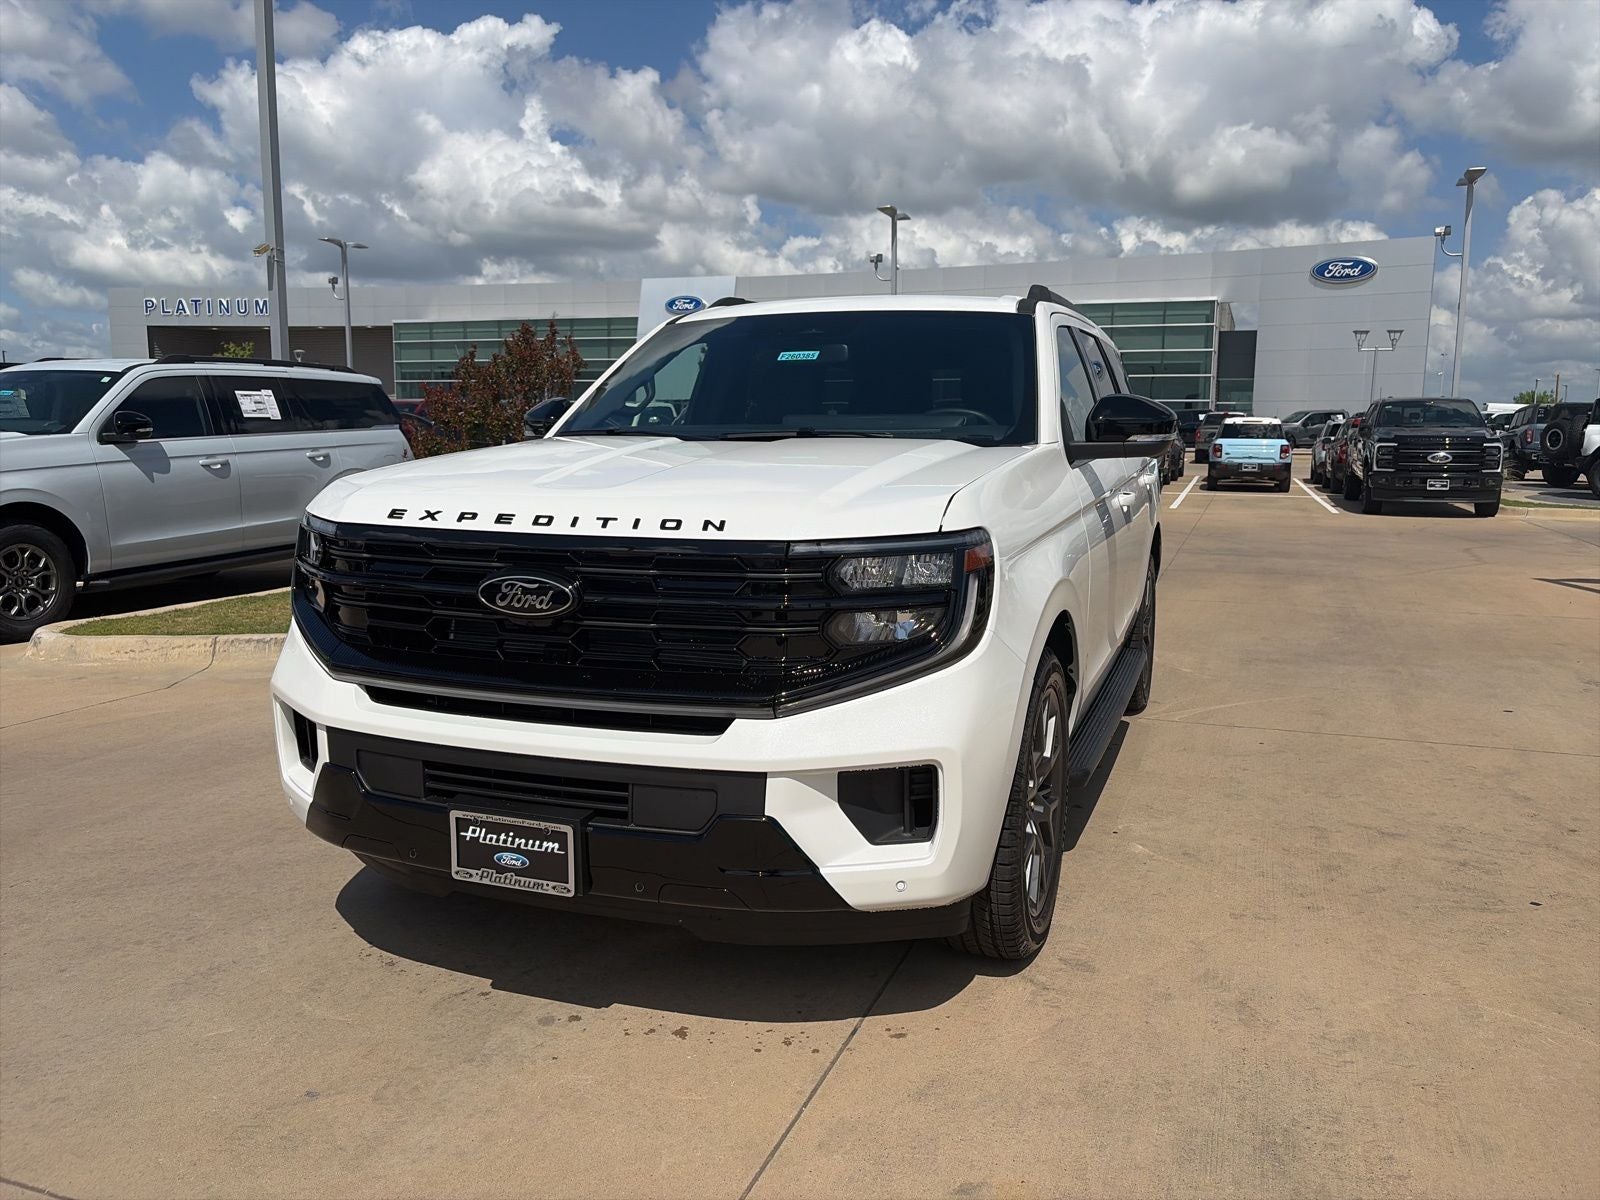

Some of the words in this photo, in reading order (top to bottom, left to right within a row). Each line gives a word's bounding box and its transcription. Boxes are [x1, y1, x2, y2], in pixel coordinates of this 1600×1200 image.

[1324, 261, 1363, 277] Ford
[144, 298, 270, 316] PLATINUM
[672, 299, 696, 310] Ford
[387, 508, 726, 532] EXPEDITION
[495, 580, 553, 610] Ford
[460, 826, 566, 854] Platinum
[500, 854, 523, 867] Ford
[479, 870, 549, 892] Platinum
